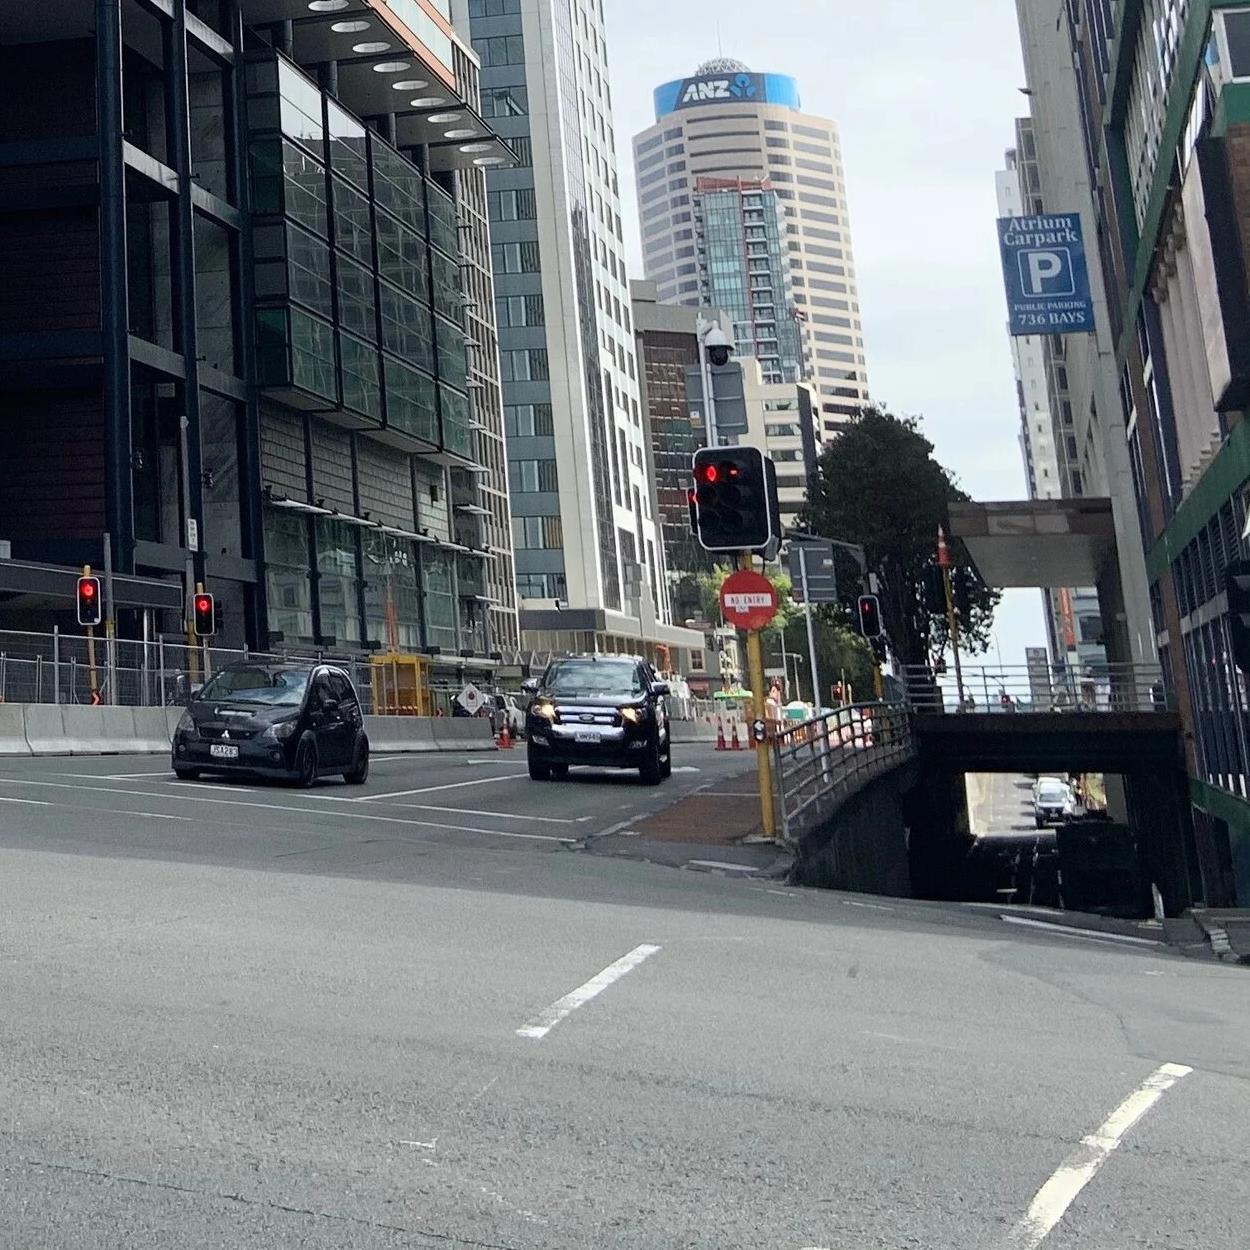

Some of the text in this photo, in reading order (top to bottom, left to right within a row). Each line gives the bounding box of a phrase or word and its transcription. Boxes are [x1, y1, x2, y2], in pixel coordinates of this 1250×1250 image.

[682, 80, 730, 103] ANZ
[1009, 215, 1072, 232] Atrium
[1003, 228, 1078, 247] Carpark
[1027, 252, 1062, 294] P
[1014, 300, 1087, 312] PUBLIC PARKING
[1018, 311, 1086, 326] 736 BAYS
[730, 596, 764, 605] NO ENTRY
